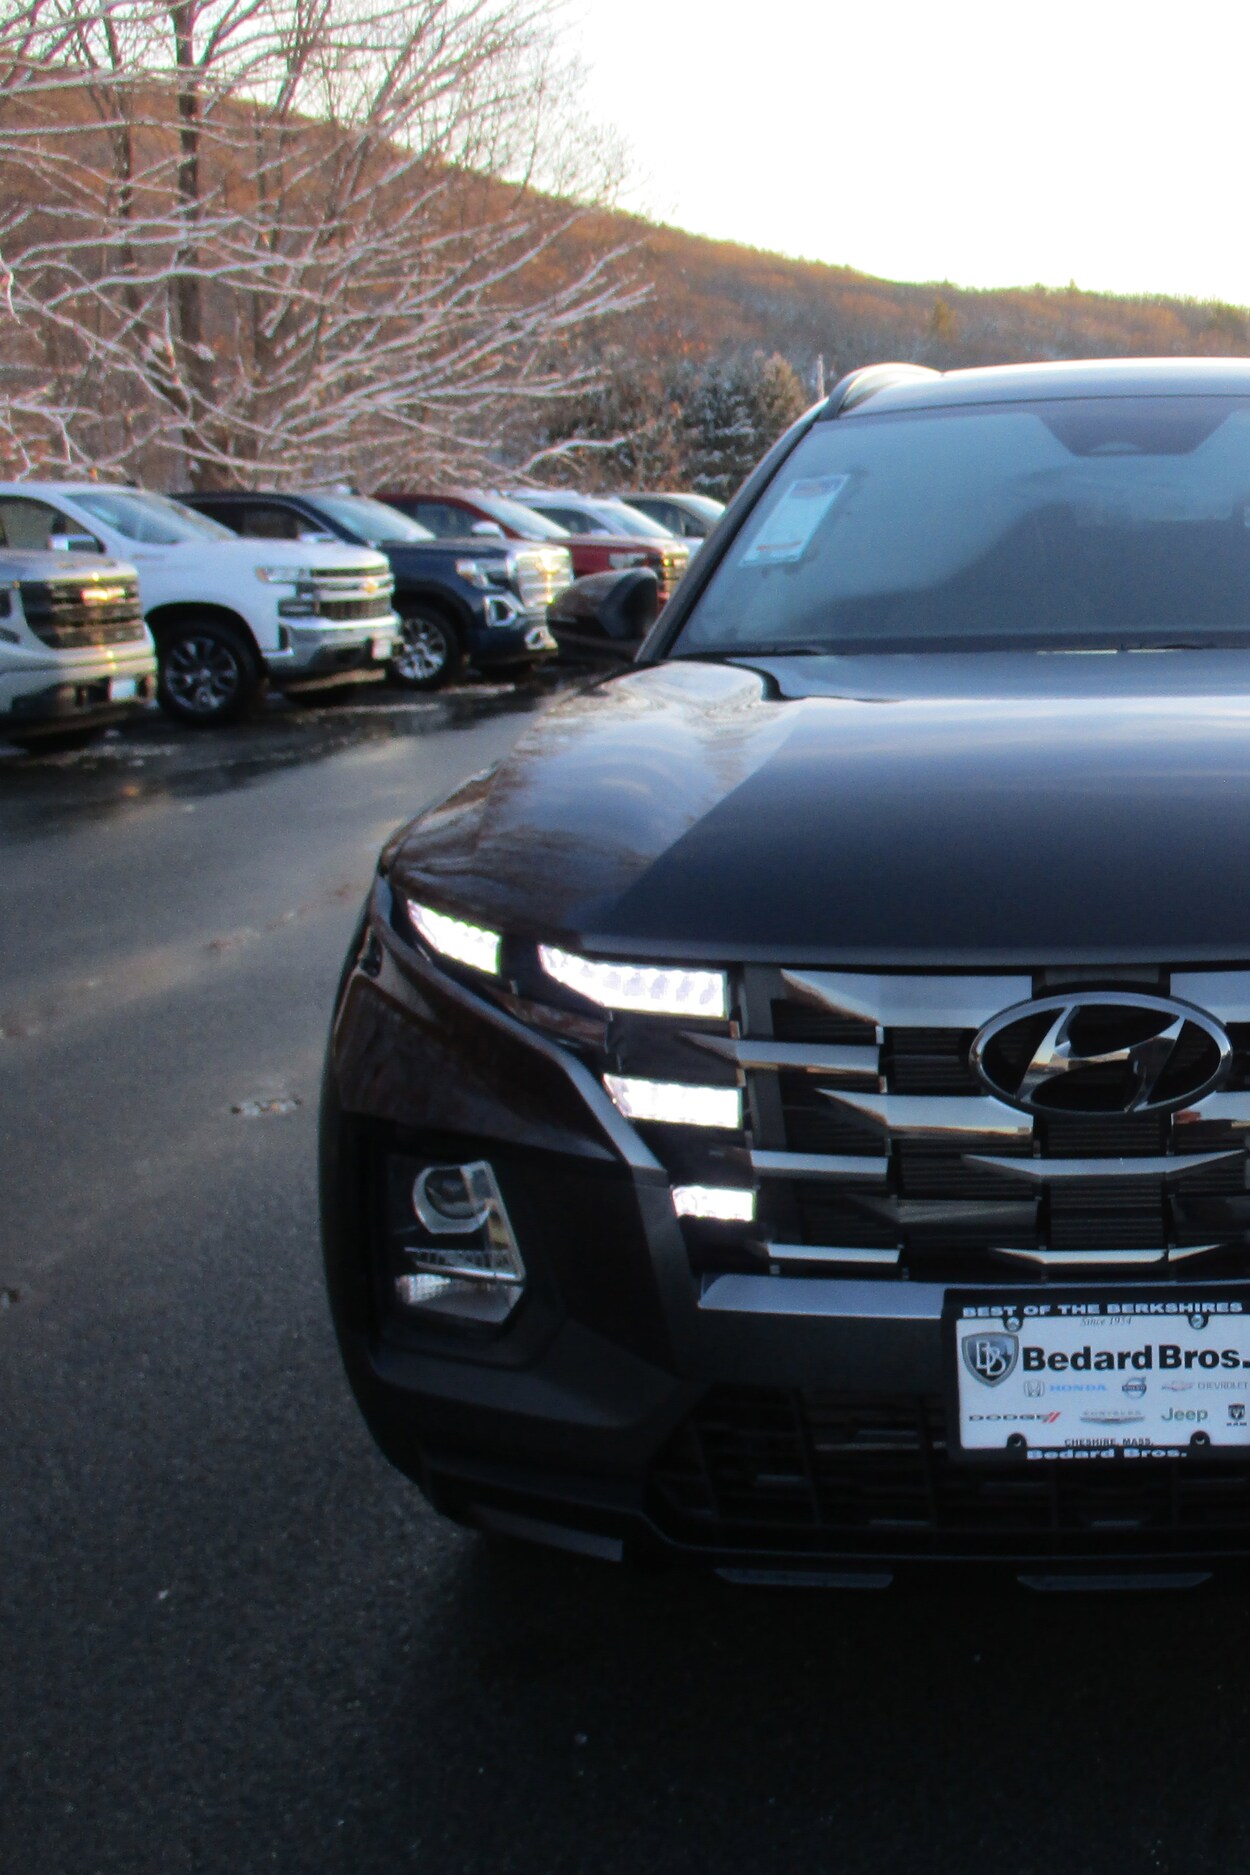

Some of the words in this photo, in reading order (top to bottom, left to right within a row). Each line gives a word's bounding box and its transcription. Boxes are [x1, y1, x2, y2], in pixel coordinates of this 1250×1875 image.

[963, 1306, 1017, 1317] BEST
[1023, 1305, 1051, 1315] OF
[1057, 1304, 1100, 1315] THE
[1106, 1302, 1243, 1314] BERKSHIRES
[1022, 1345, 1153, 1371] Bedard
[1158, 1344, 1250, 1369] Bros.
[1050, 1384, 1107, 1392] HONDA
[1197, 1382, 1249, 1391] CHEVROLET
[1161, 1407, 1208, 1423] Jeep
[1026, 1448, 1115, 1459] Bedard
[1123, 1448, 1188, 1459] Bros.
